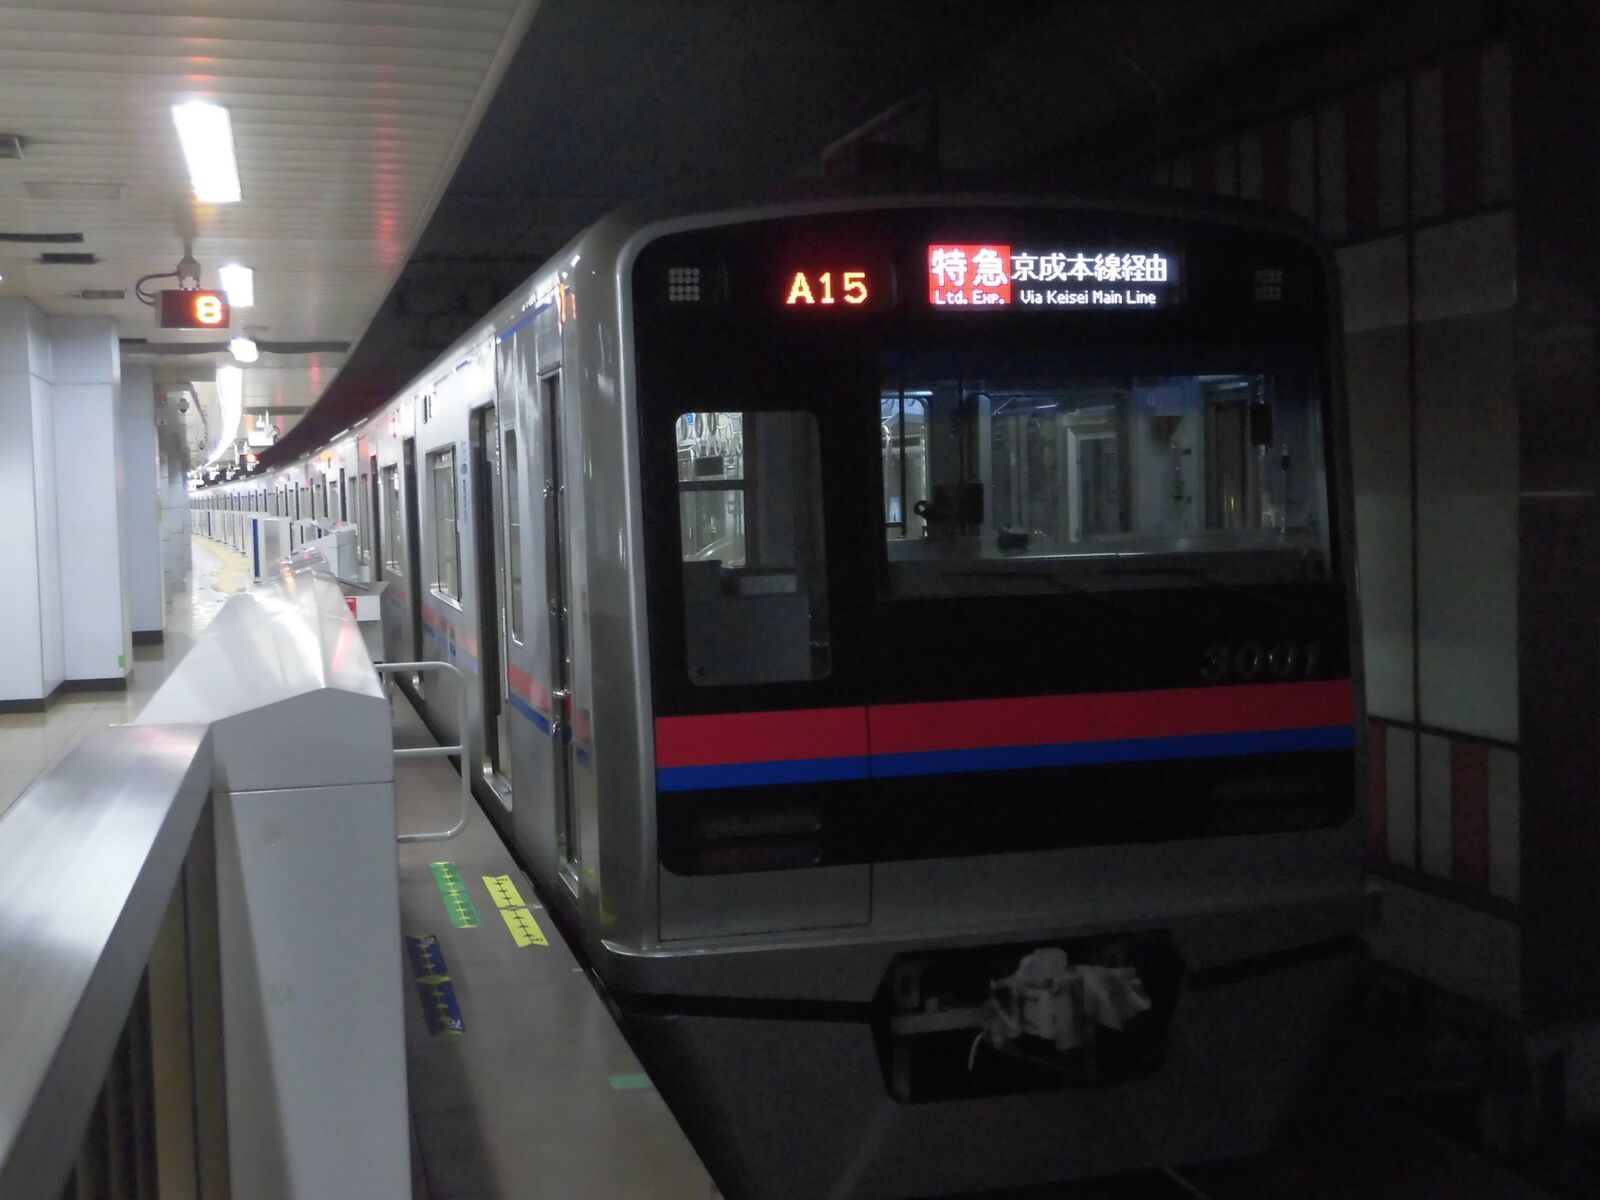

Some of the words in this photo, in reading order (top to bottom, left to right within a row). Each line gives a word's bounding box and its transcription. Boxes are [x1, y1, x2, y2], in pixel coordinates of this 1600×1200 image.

[931, 248, 1008, 287] 特急
[1011, 252, 1167, 282] 京成本線経由
[786, 272, 867, 304] A15
[935, 290, 968, 305] Ltd.
[972, 290, 1004, 305] Exp.
[1020, 290, 1043, 304] Via
[1047, 290, 1089, 304] Keisei
[1092, 290, 1122, 304] Main
[1126, 290, 1157, 304] Line
[196, 296, 222, 324] 8
[1200, 641, 1319, 678] 3001
